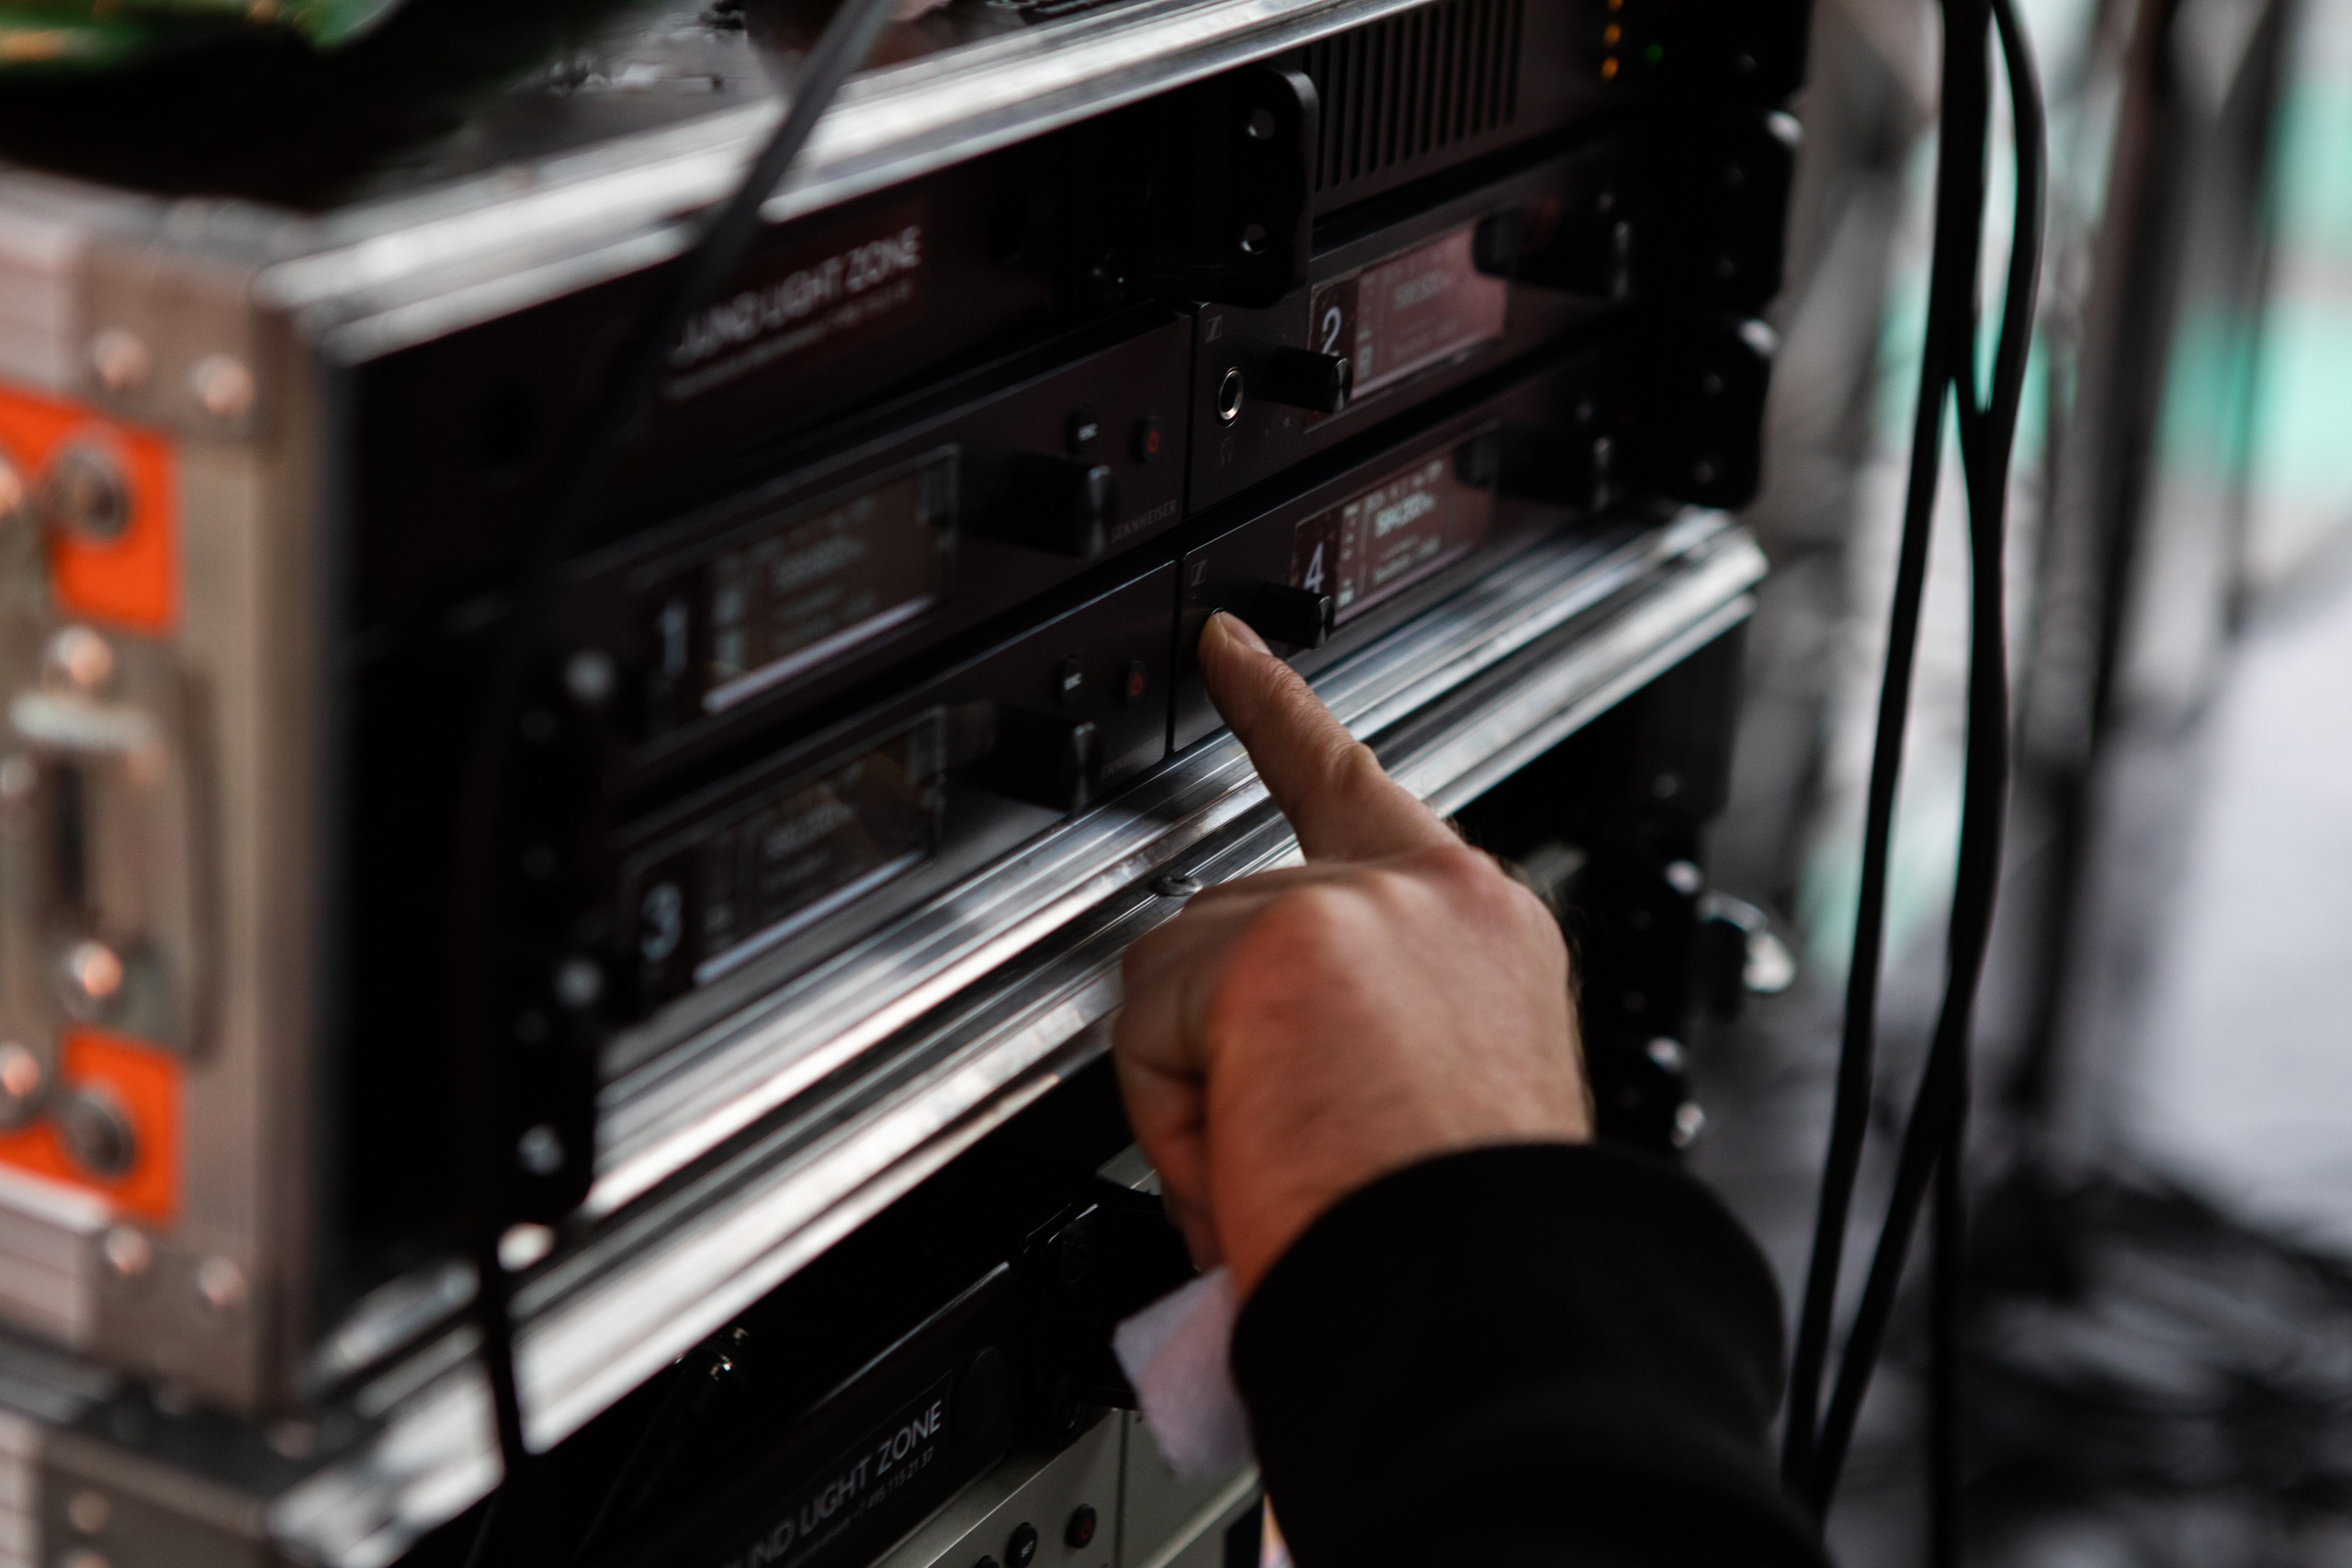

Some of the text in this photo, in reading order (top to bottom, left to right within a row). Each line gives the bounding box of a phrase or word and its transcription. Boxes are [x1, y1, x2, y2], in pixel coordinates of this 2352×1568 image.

[843, 225, 922, 294] ZONE
[1320, 305, 1342, 356] 2
[1303, 541, 1325, 595] 4
[656, 599, 689, 676] 1
[639, 881, 684, 963] 3
[800, 1452, 874, 1538] LIGHT
[876, 1398, 943, 1478] ZONE
